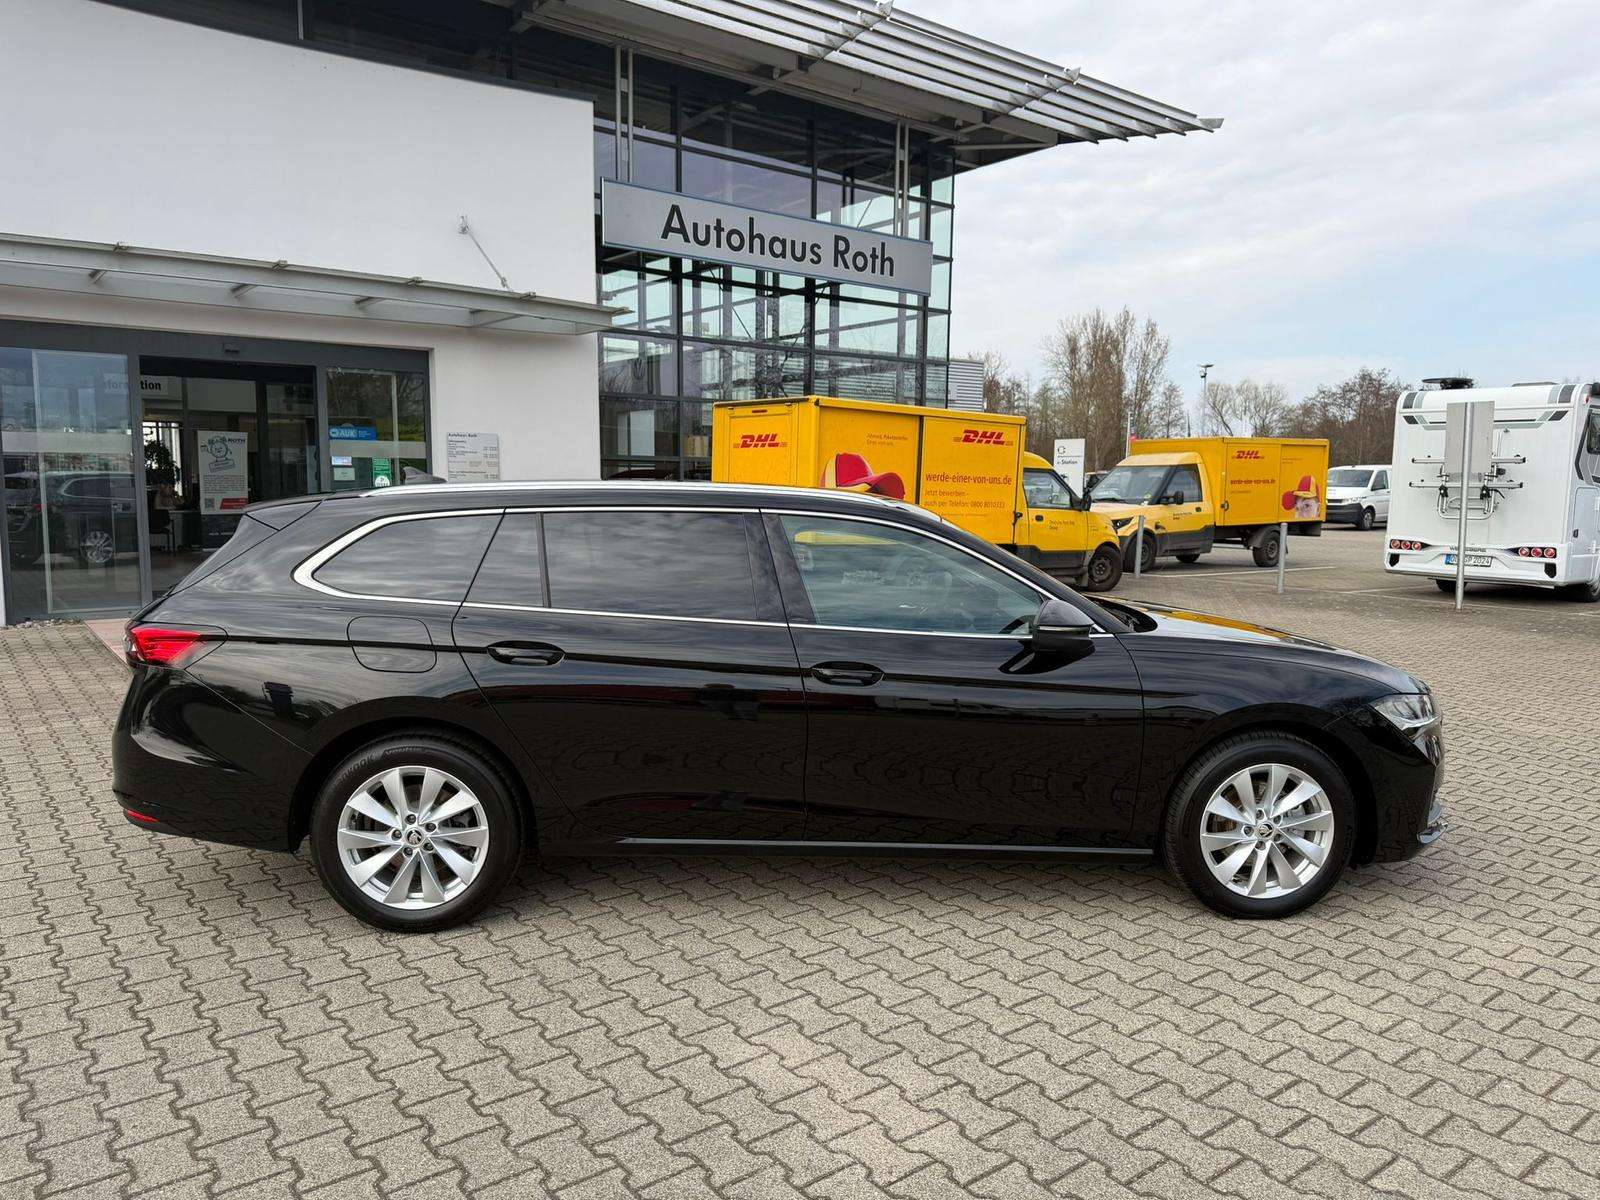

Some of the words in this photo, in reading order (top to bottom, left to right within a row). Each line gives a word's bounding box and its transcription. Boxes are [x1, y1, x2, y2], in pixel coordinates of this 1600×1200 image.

[660, 203, 822, 265] Autohaus
[833, 234, 894, 277] Roth
[740, 433, 780, 448] DHL
[962, 429, 1005, 445] DHL
[1235, 450, 1261, 459] DHL
[925, 472, 1012, 485] werde-einer-von-uns.de
